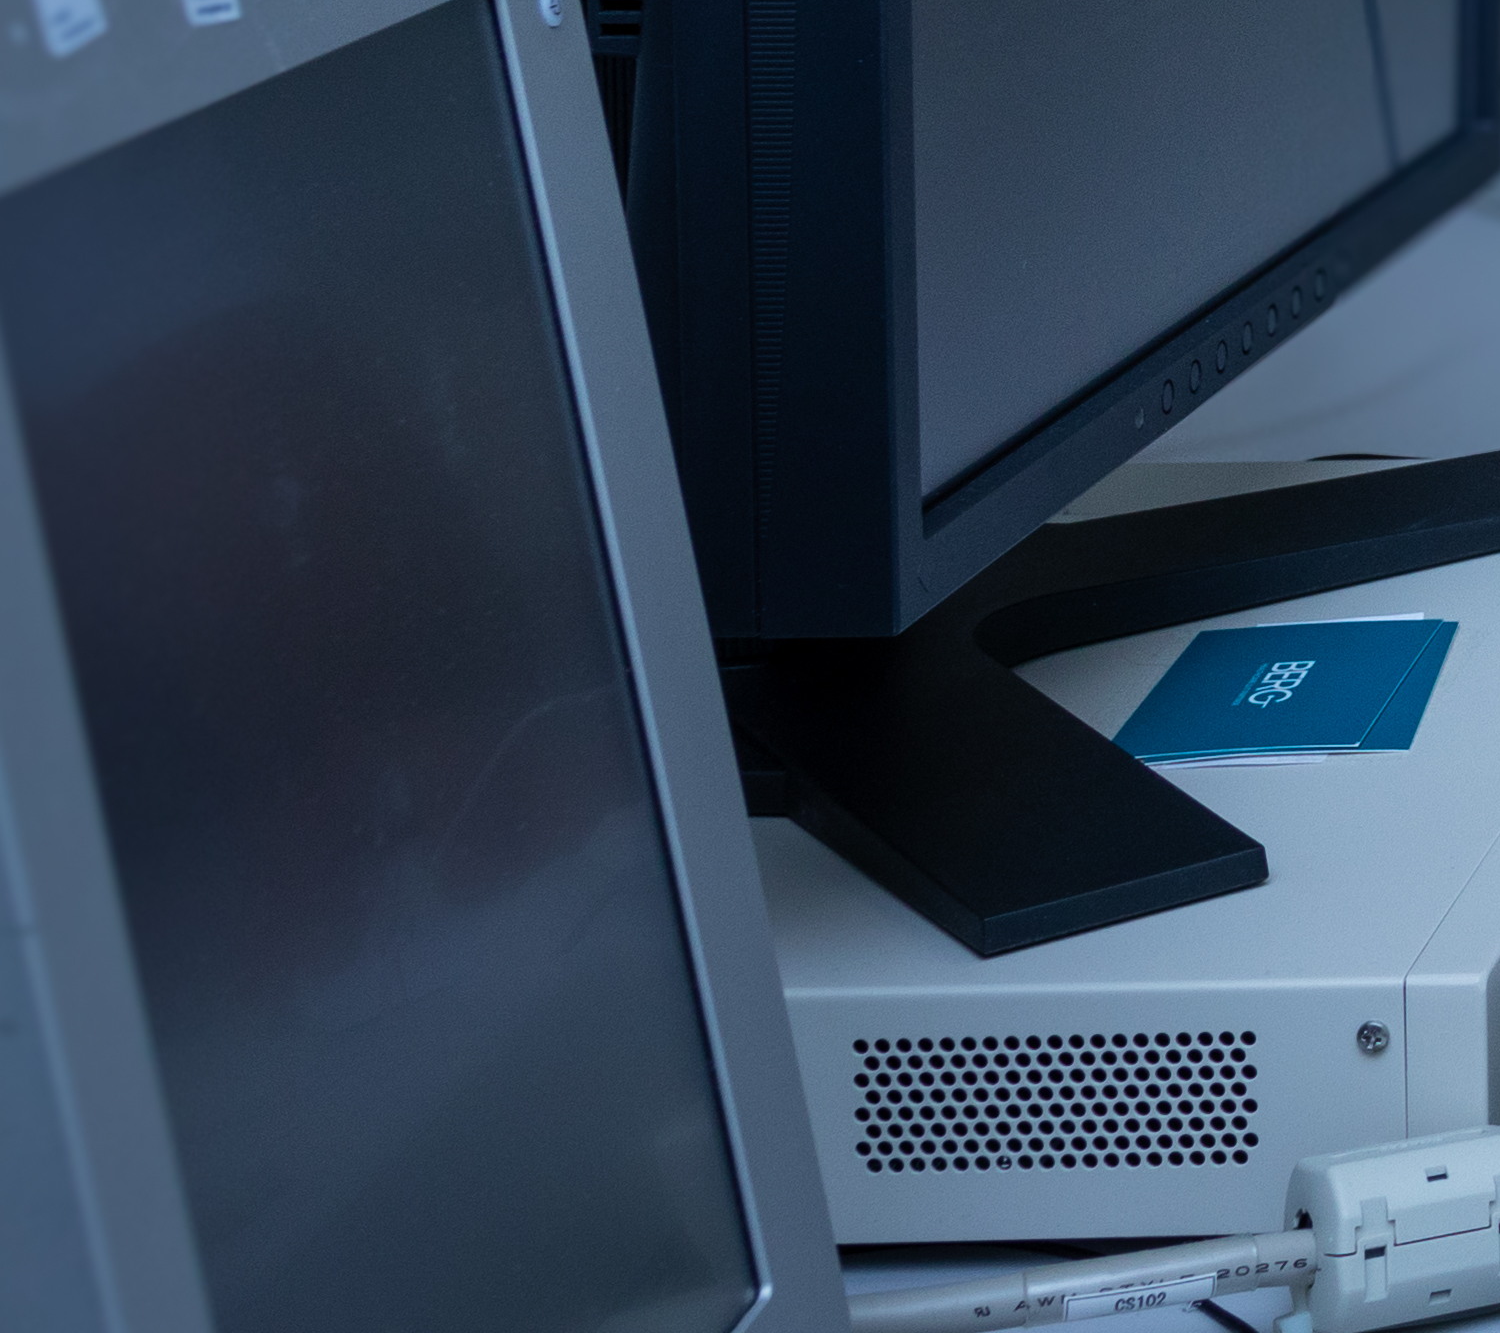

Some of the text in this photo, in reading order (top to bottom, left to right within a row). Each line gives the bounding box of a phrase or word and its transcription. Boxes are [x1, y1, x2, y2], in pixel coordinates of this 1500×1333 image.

[1248, 660, 1316, 708] BERG
[1216, 1258, 1309, 1280] 20276
[1113, 1291, 1167, 1312] CS102
